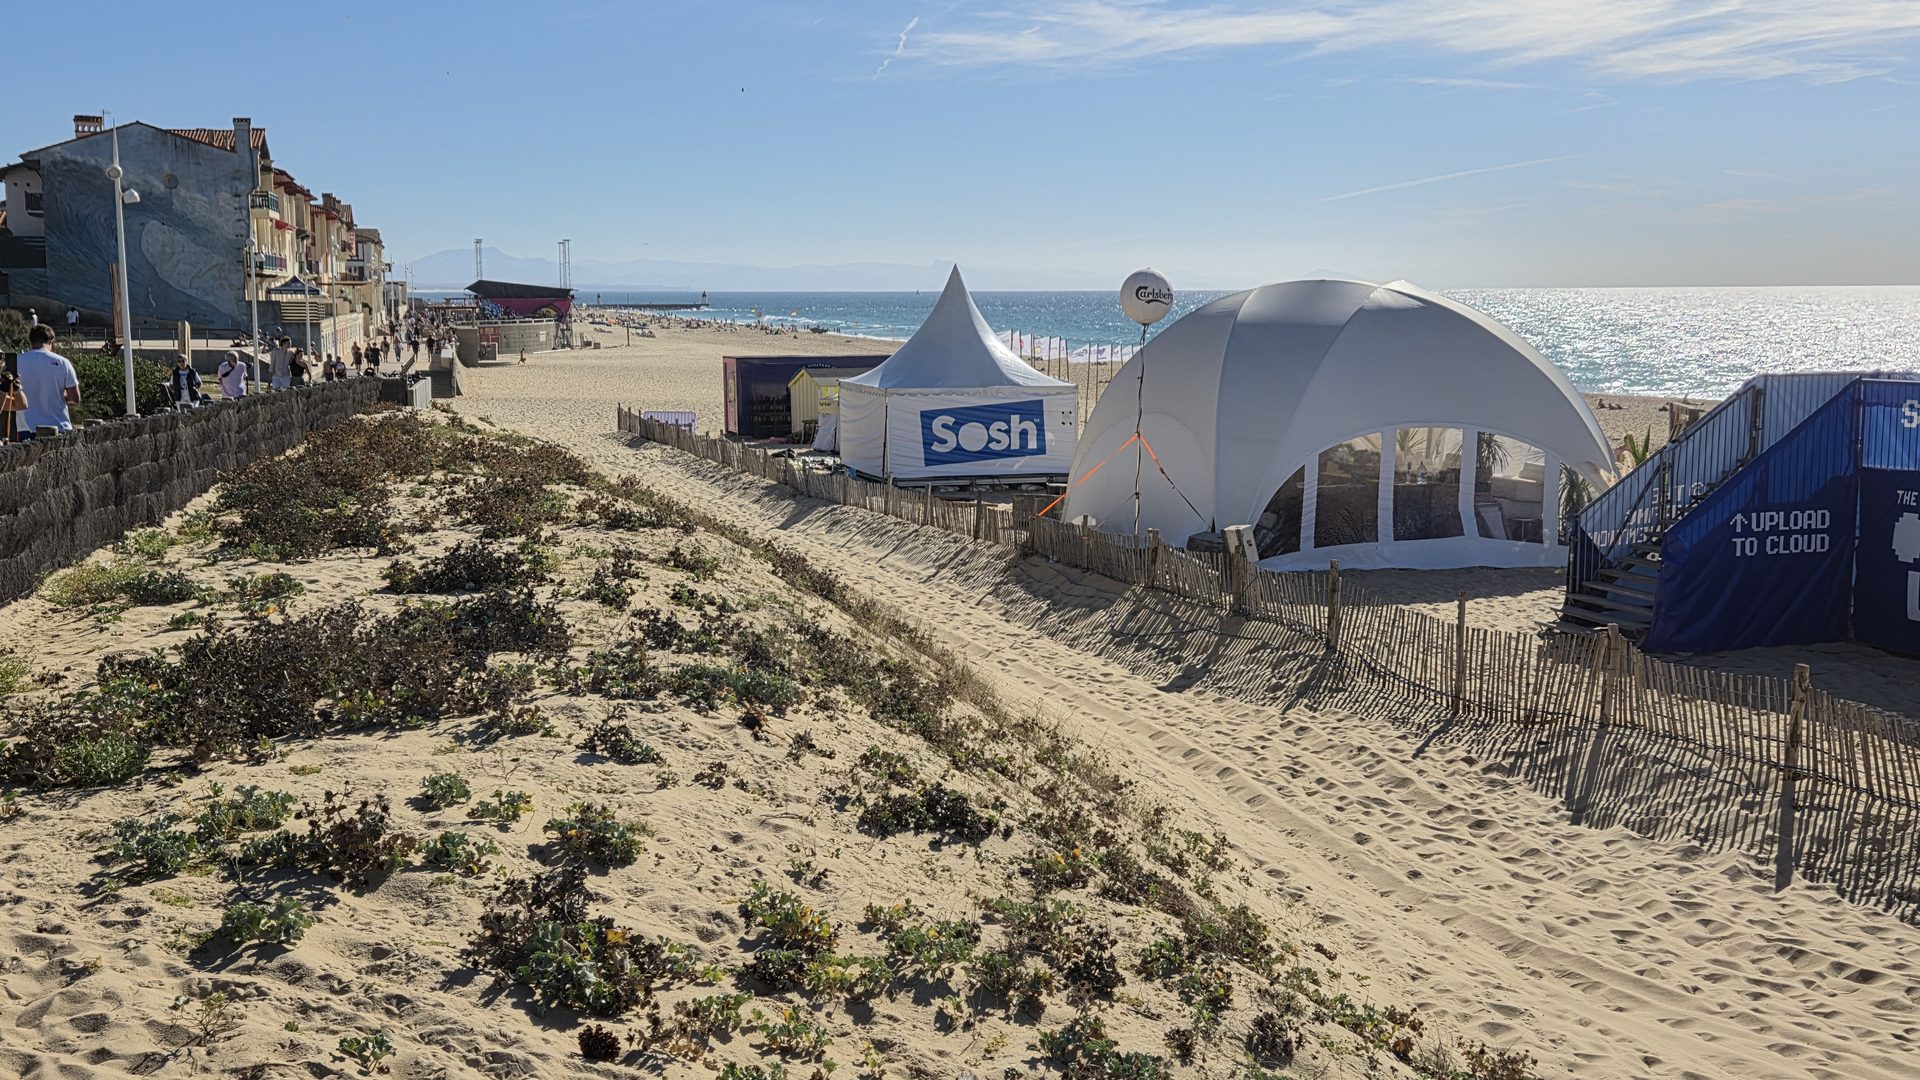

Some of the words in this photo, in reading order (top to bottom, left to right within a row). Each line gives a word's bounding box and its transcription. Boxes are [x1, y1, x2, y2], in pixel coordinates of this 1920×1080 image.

[931, 414, 1037, 453] Sosh
[1896, 489, 1919, 506] THE
[1751, 509, 1830, 532] UPLOAD
[1731, 537, 1758, 557] TO
[1765, 533, 1830, 555] CLOUD
